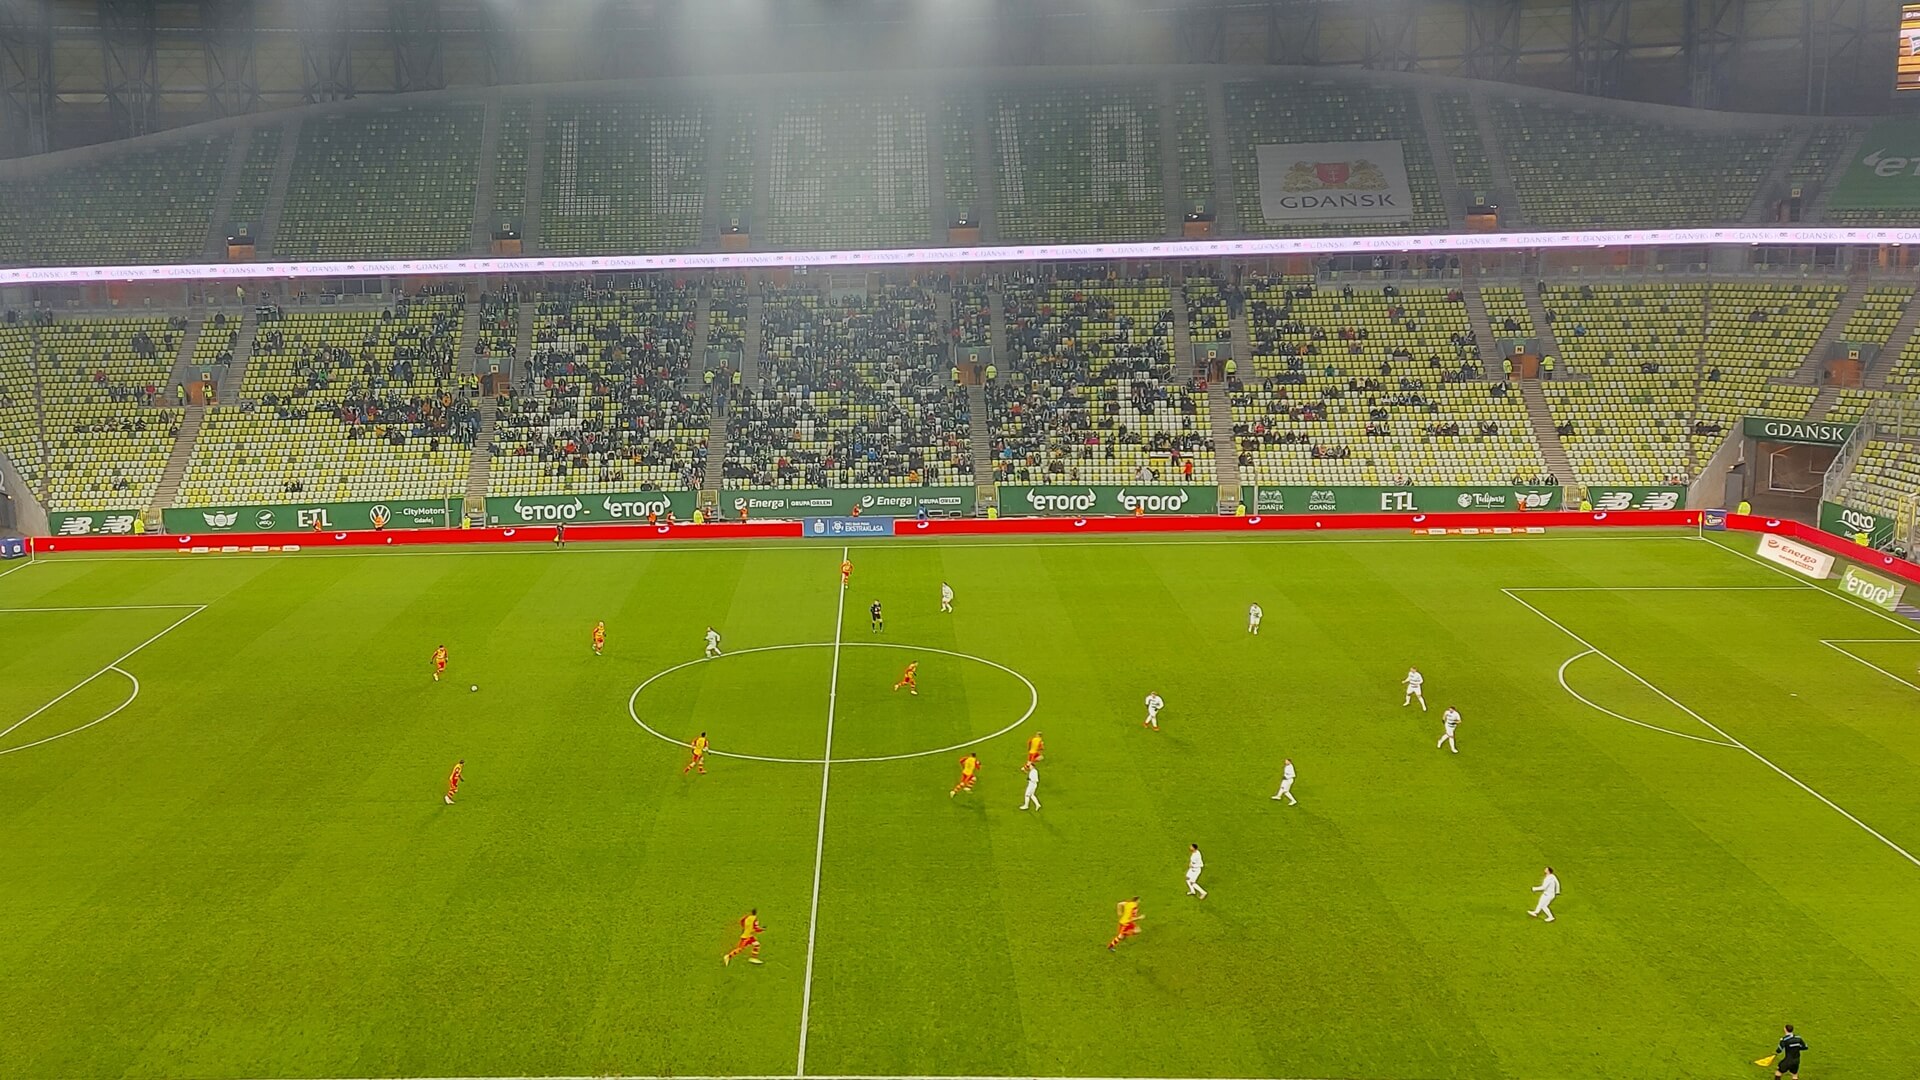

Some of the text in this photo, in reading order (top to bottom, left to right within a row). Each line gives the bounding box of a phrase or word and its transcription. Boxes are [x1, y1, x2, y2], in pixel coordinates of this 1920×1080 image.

[1280, 193, 1396, 208] GDAŃSK
[1765, 422, 1844, 441] GDAŃSK
[749, 499, 784, 509] Energa
[877, 497, 912, 507] Energa
[1308, 503, 1336, 511] GDAŃSK
[1381, 491, 1418, 511] ETL
[298, 508, 332, 527] ETL
[403, 508, 445, 516] CityMotors
[1781, 545, 1817, 564] Energa
